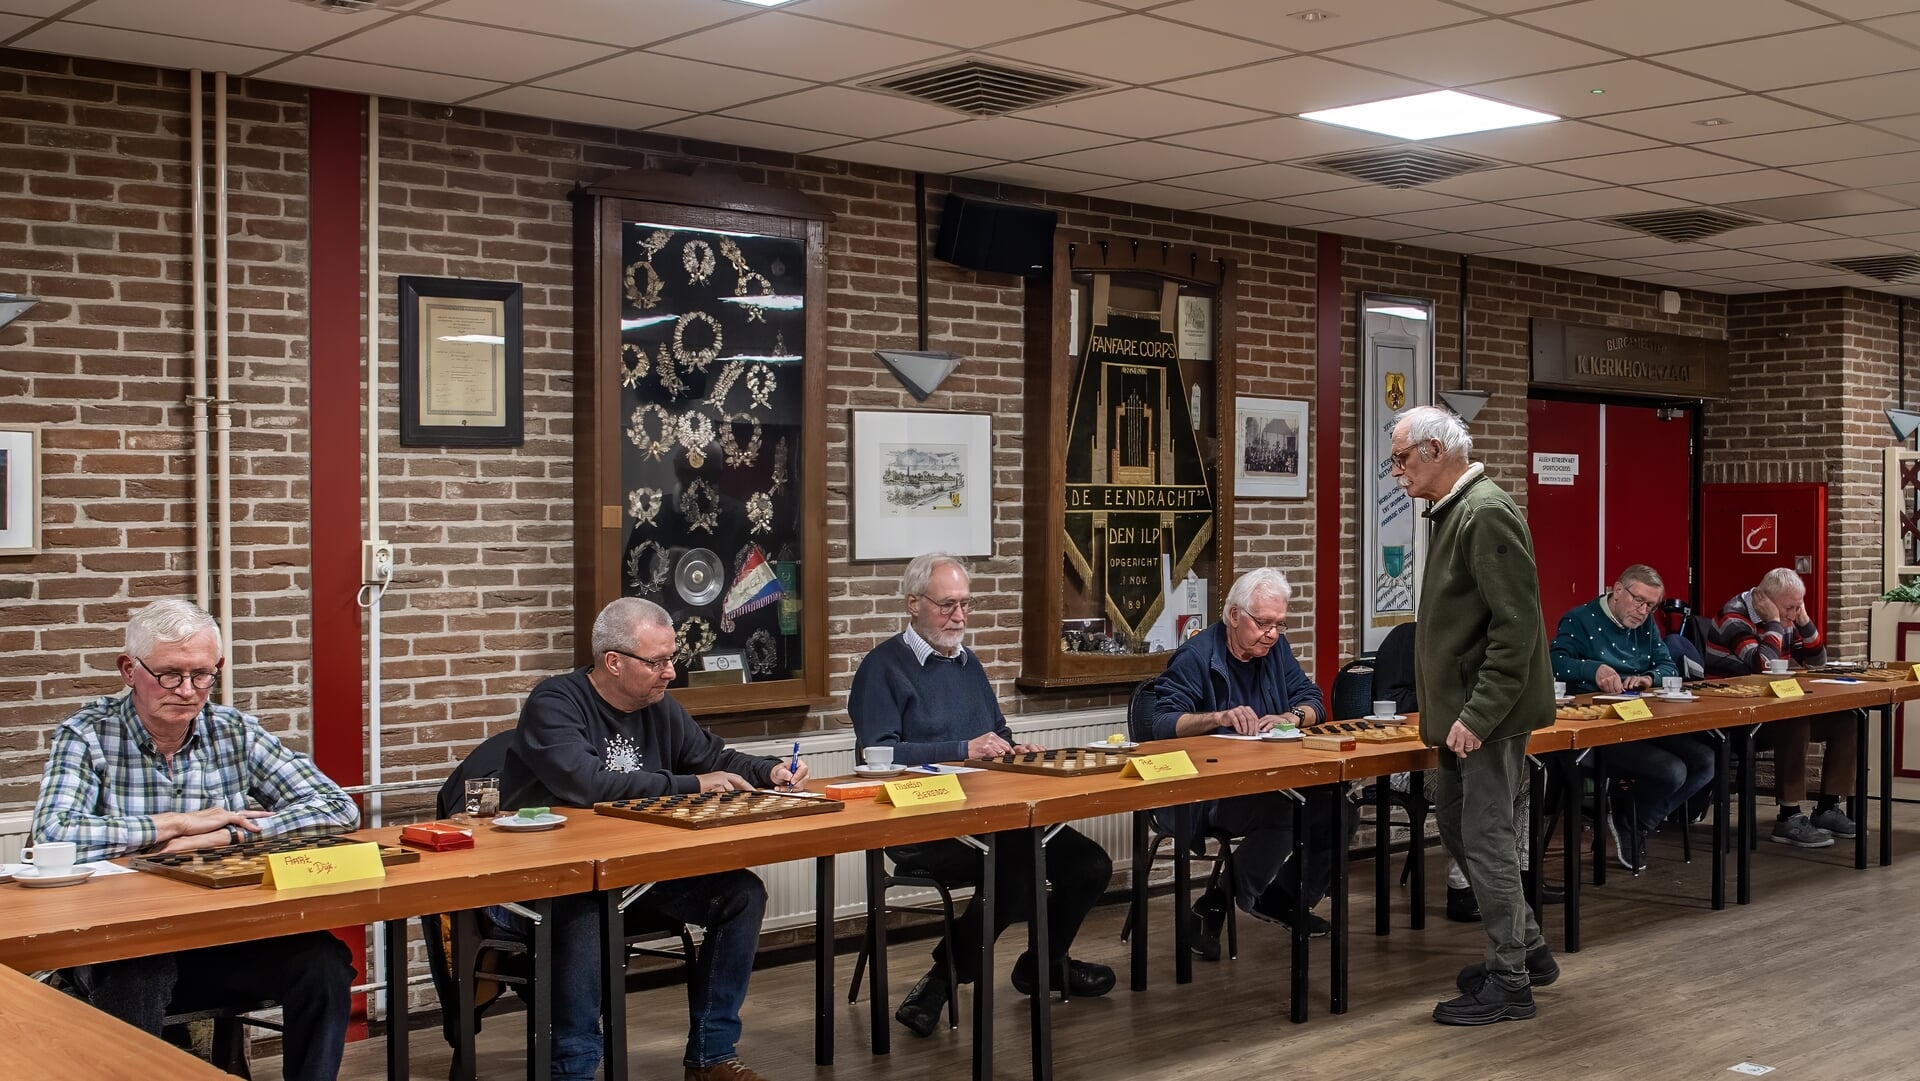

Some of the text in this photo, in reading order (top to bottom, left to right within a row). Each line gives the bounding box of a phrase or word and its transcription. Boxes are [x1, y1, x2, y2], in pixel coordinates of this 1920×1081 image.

[1092, 336, 1176, 359] FANFARE CORPS
[1071, 489, 1092, 506] DE
[1109, 527, 1160, 545] DEN ILP
[1109, 557, 1159, 568] OPGERICHT
[1129, 575, 1149, 586] NOV.
